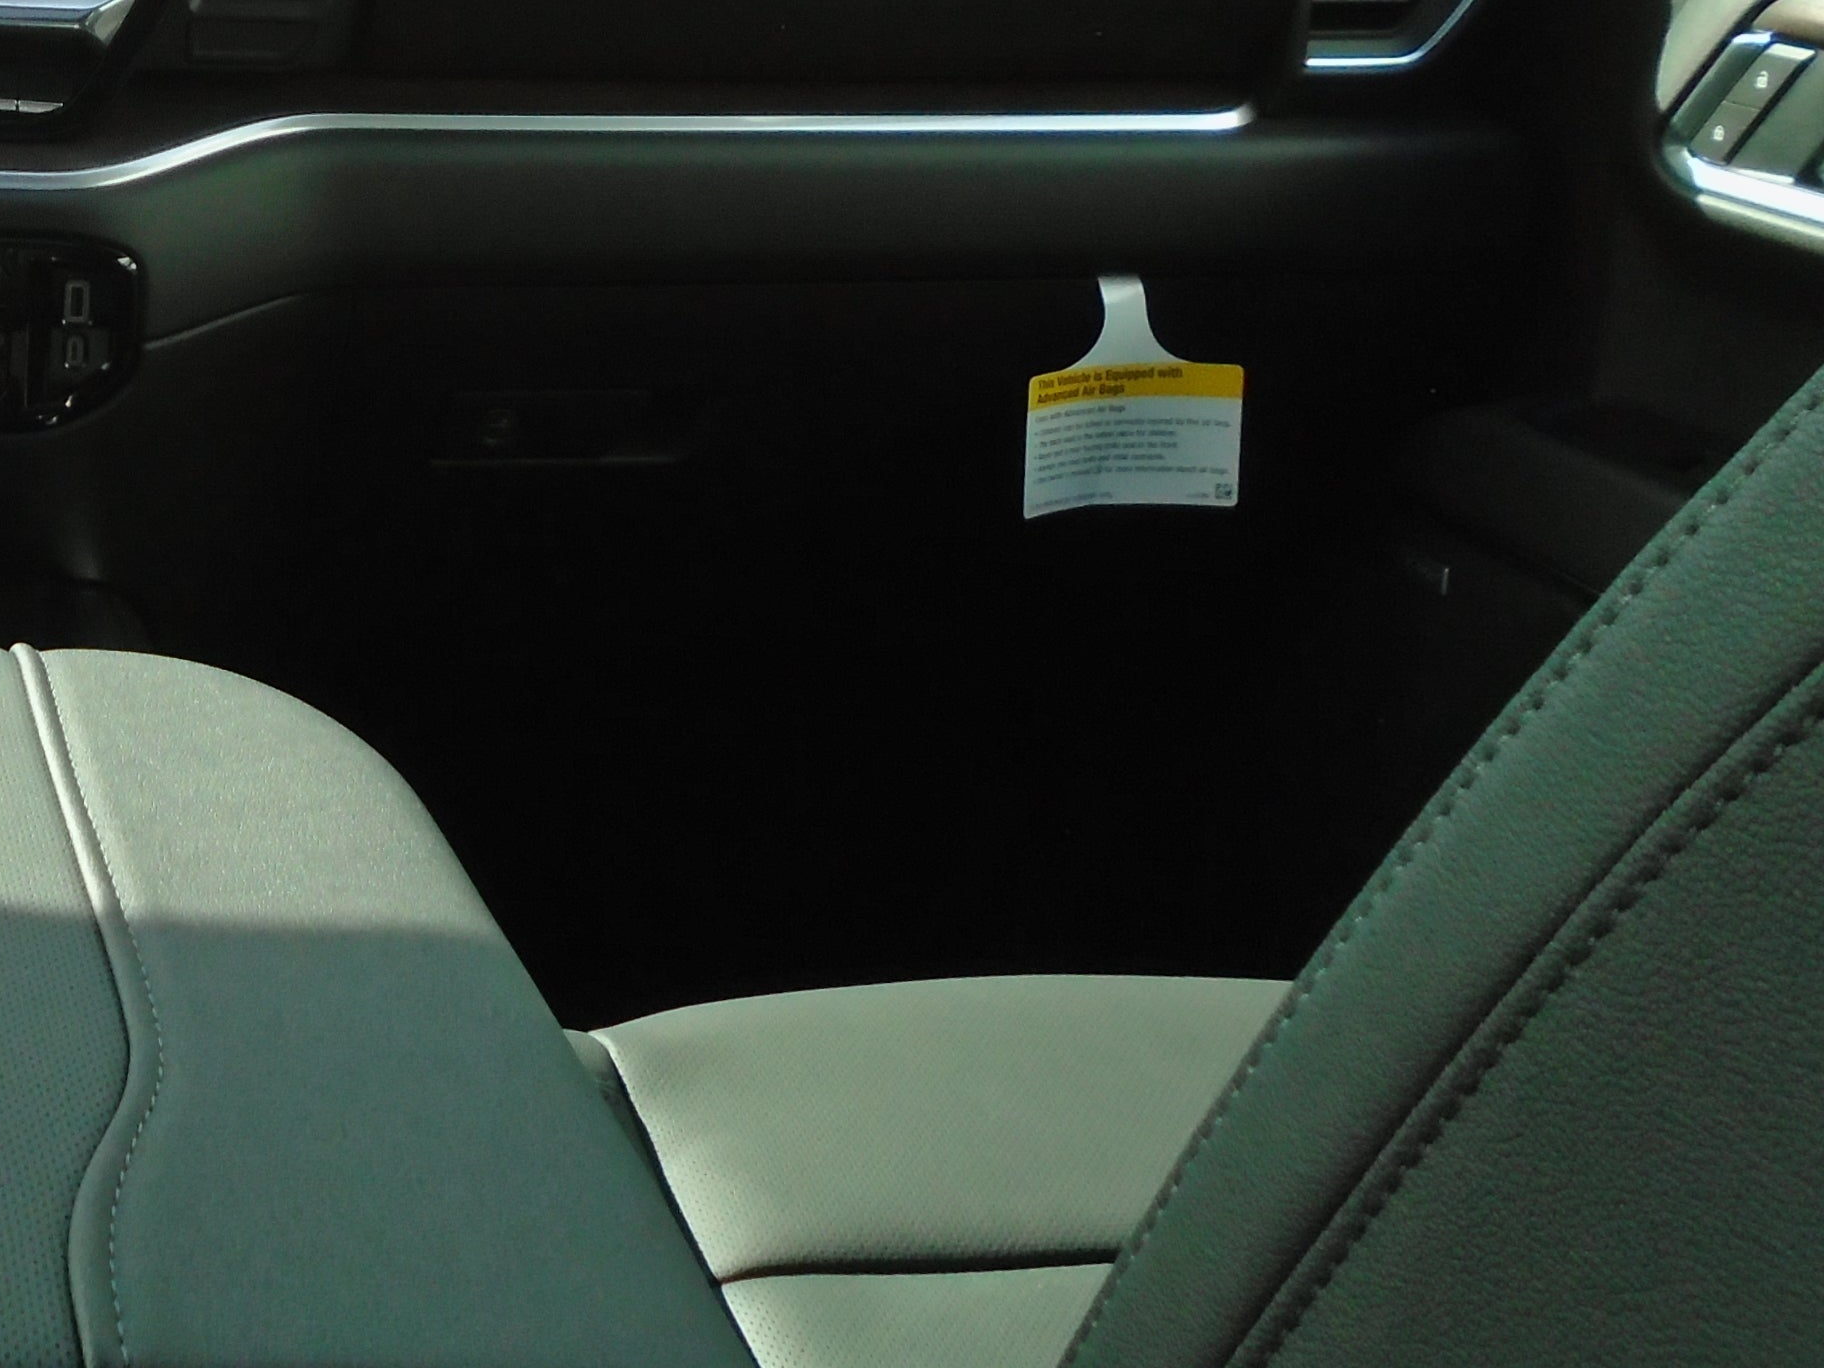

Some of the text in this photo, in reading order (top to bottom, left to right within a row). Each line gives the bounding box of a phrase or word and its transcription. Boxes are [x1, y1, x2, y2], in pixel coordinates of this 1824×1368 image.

[1038, 379, 1054, 389] This
[1093, 372, 1102, 381] is
[1105, 367, 1155, 382] Equipped
[1157, 367, 1183, 379] with
[1037, 383, 1125, 404] Advanced Air Bags
